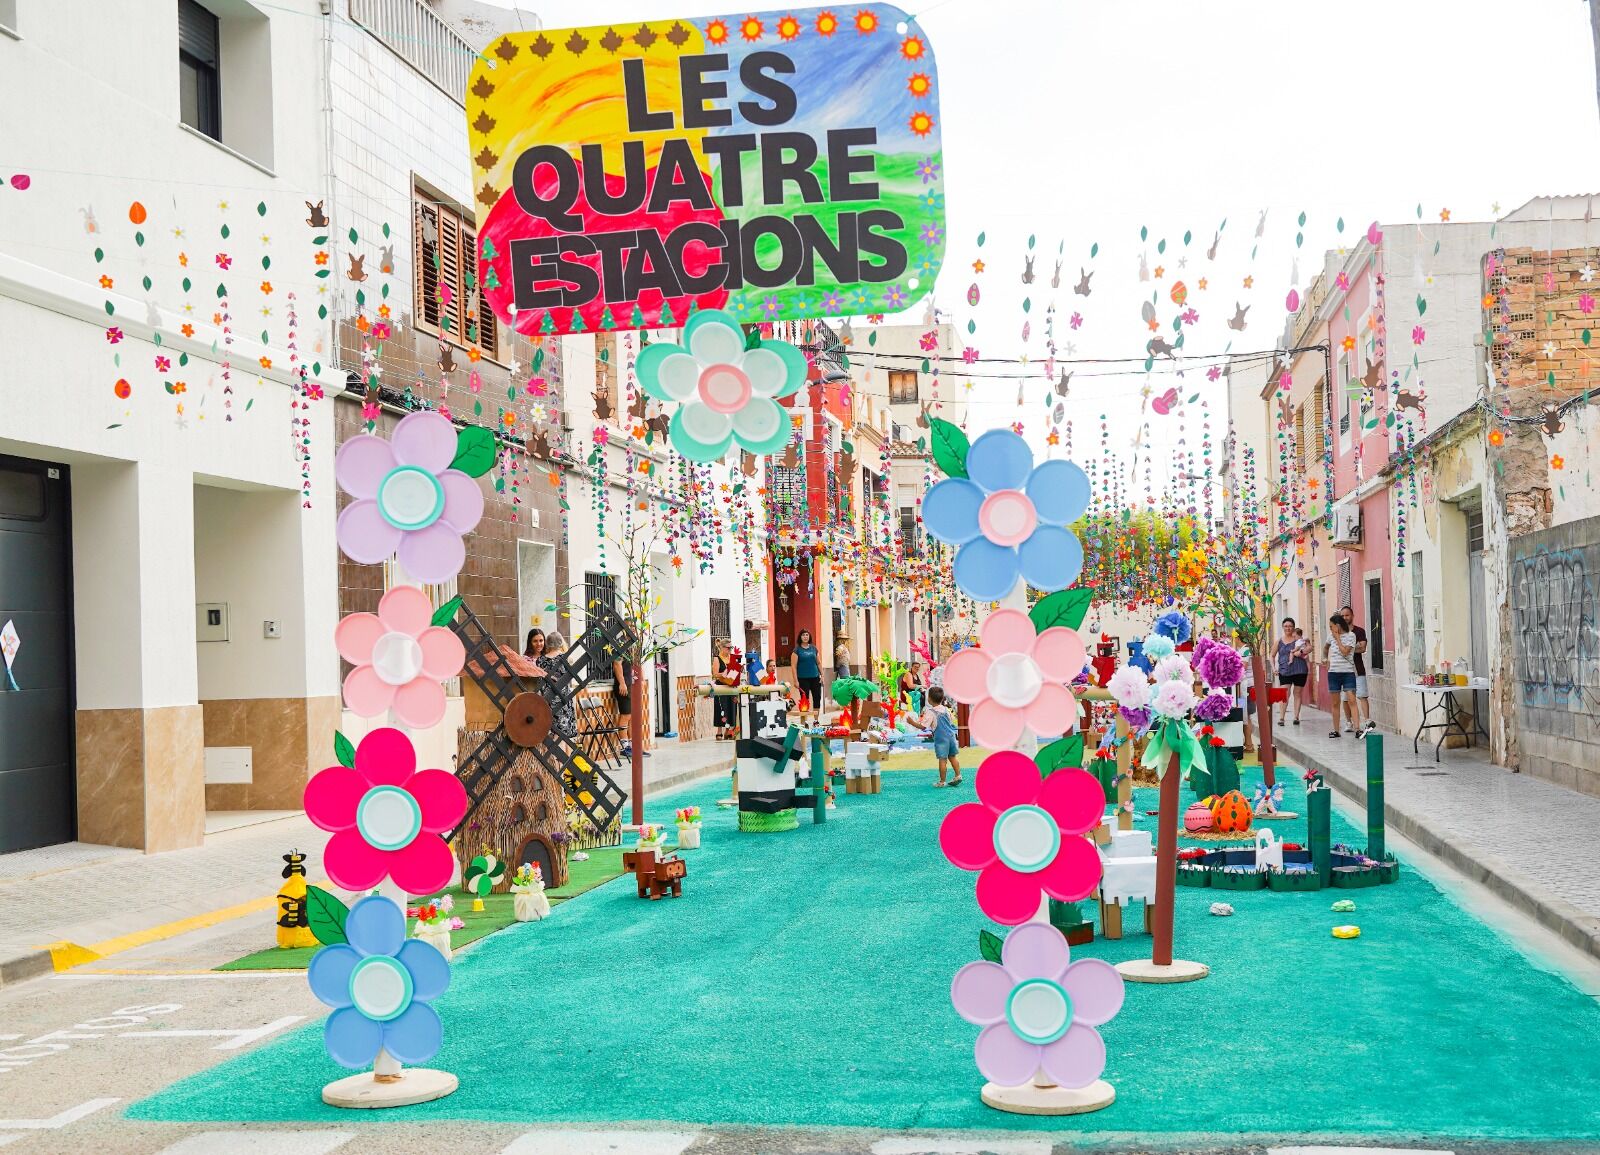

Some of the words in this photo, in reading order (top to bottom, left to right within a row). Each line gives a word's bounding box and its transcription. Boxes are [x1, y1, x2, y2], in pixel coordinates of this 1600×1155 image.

[622, 51, 798, 133] LES
[511, 127, 880, 233] QUATRE
[509, 210, 909, 310] ESTACIONS
[0, 1003, 183, 1073] OTOS
